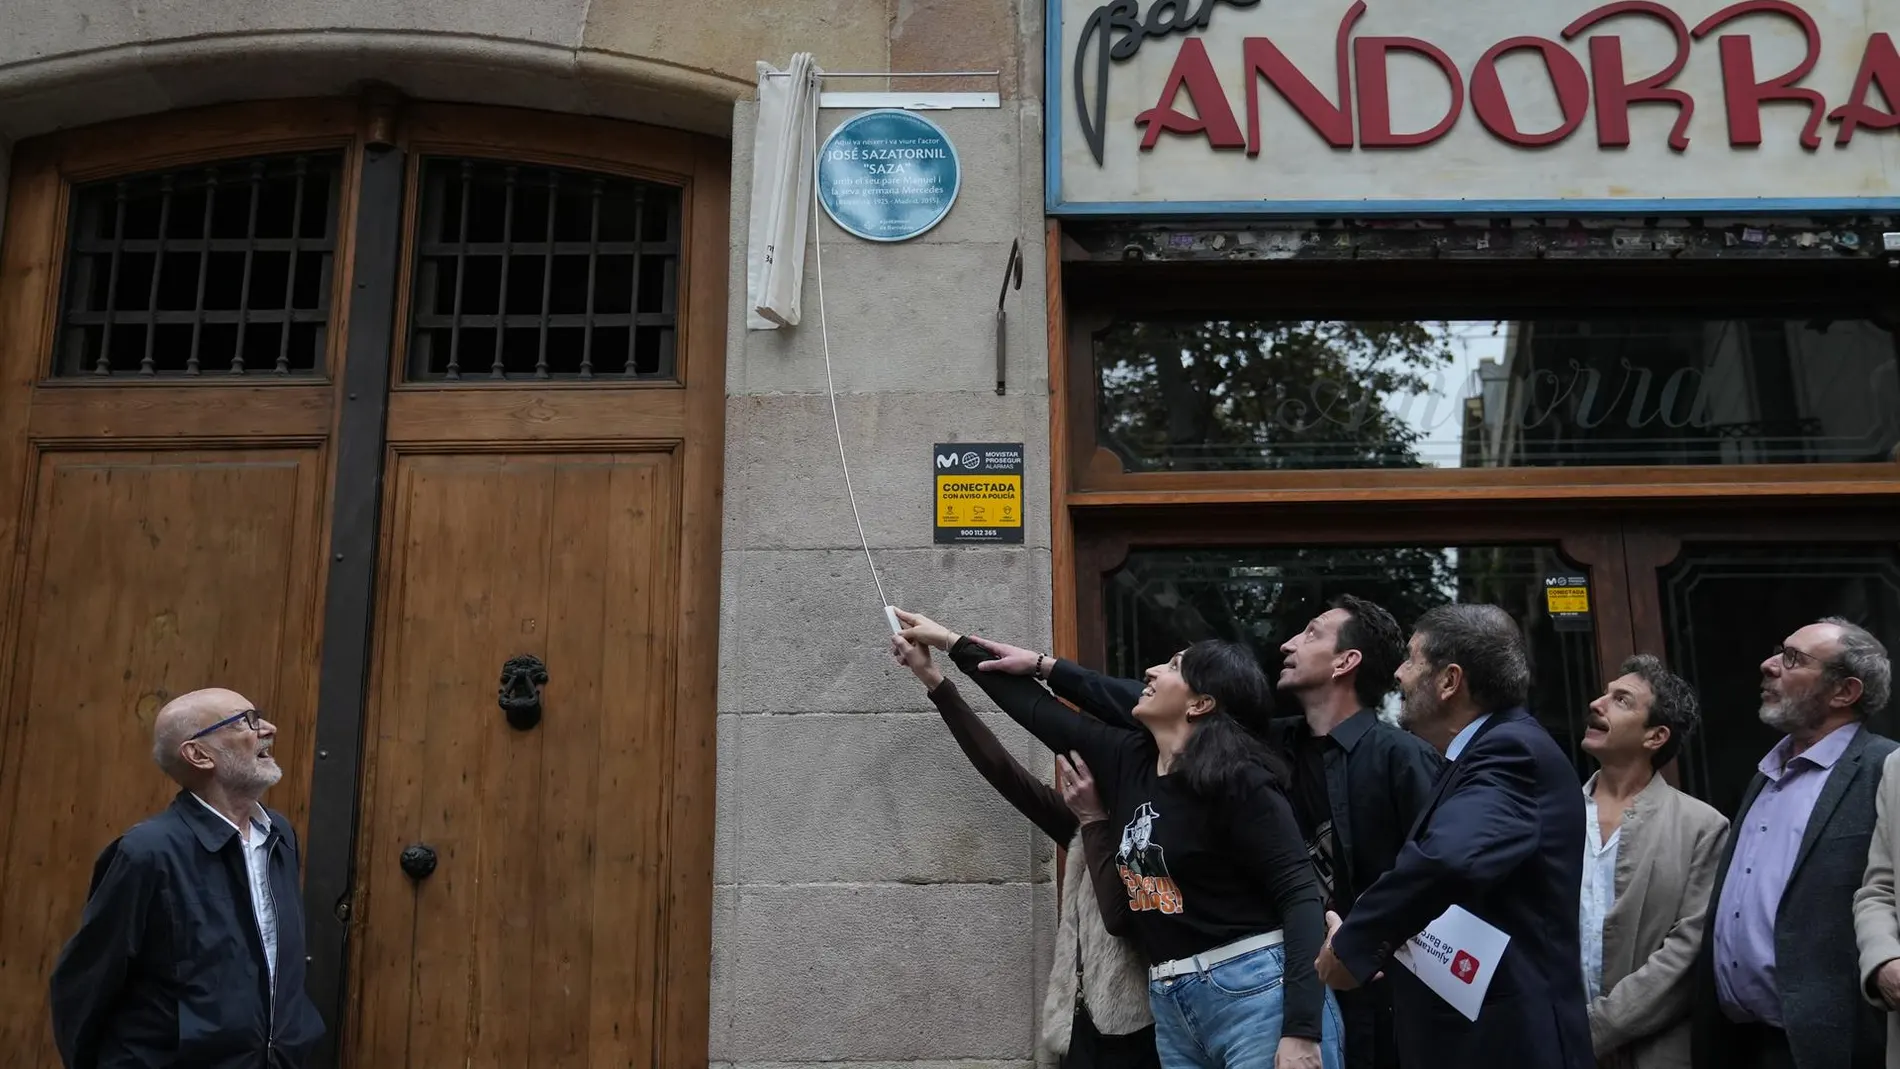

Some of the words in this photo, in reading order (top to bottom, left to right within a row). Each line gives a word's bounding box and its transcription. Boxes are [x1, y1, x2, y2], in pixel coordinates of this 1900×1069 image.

[1134, 0, 1900, 158] ANDORRA
[889, 138, 898, 146] va
[898, 137, 917, 145] viure
[827, 147, 859, 162] JOSÉ
[862, 148, 946, 160] SAZATORNIL
[863, 162, 911, 175] "SAZA"
[865, 177, 881, 185] seu
[881, 178, 900, 187] pare
[903, 175, 937, 184] Manuel
[862, 187, 900, 197] germana
[901, 185, 944, 195] Mercedes
[943, 483, 1015, 492] CONECTADA
[988, 492, 1015, 500] POLICÍA
[1441, 944, 1454, 955] de
